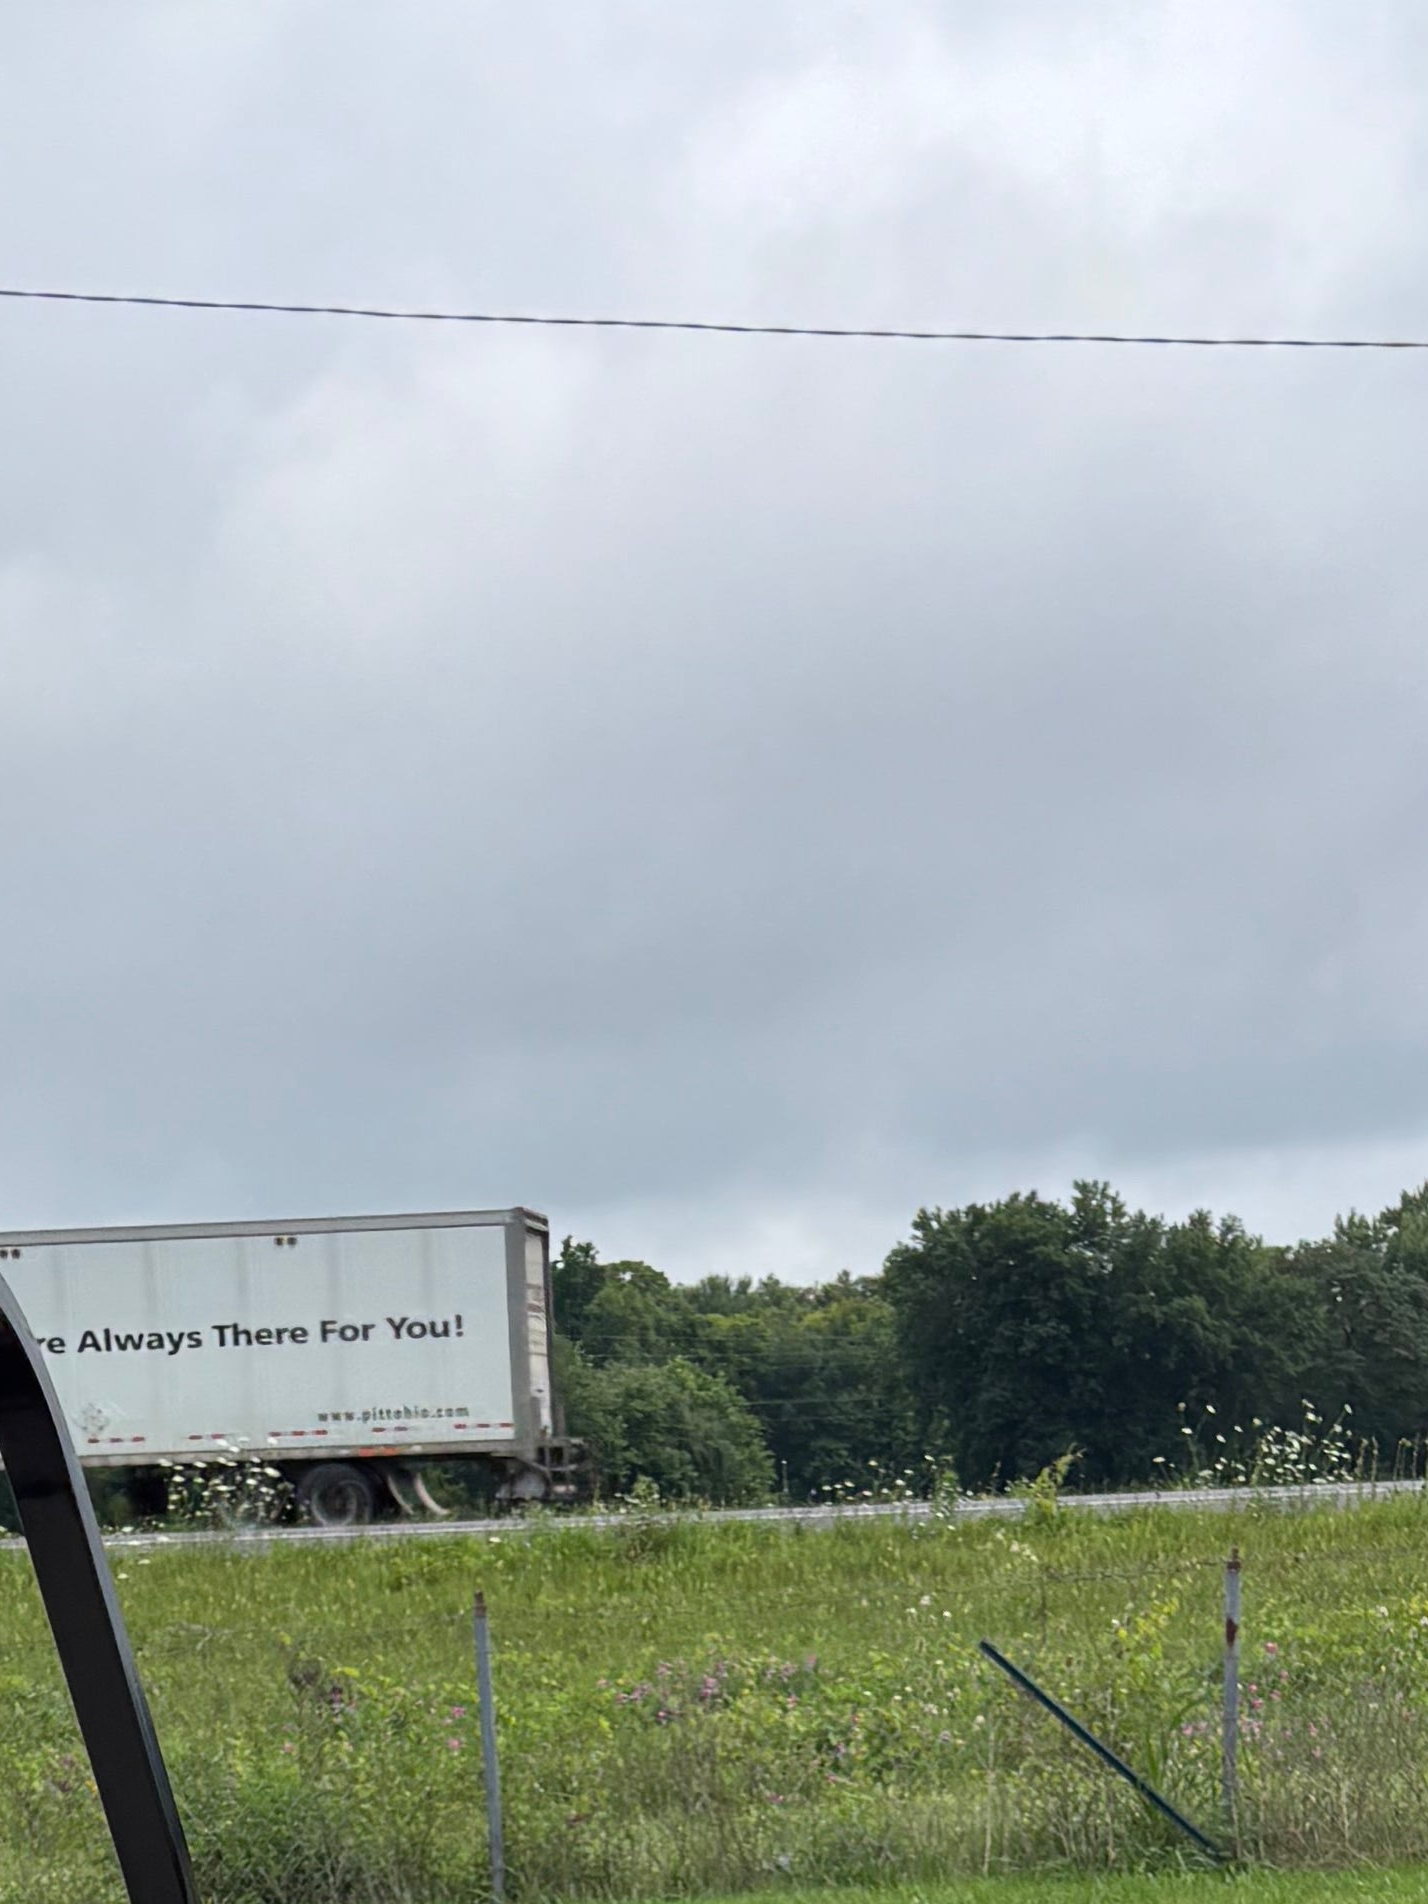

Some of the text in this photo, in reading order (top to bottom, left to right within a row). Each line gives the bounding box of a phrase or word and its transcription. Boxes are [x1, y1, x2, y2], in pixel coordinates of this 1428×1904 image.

[77, 1327, 203, 1356] Always
[211, 1322, 309, 1347] There
[320, 1319, 376, 1343] For
[386, 1314, 465, 1340] You!
